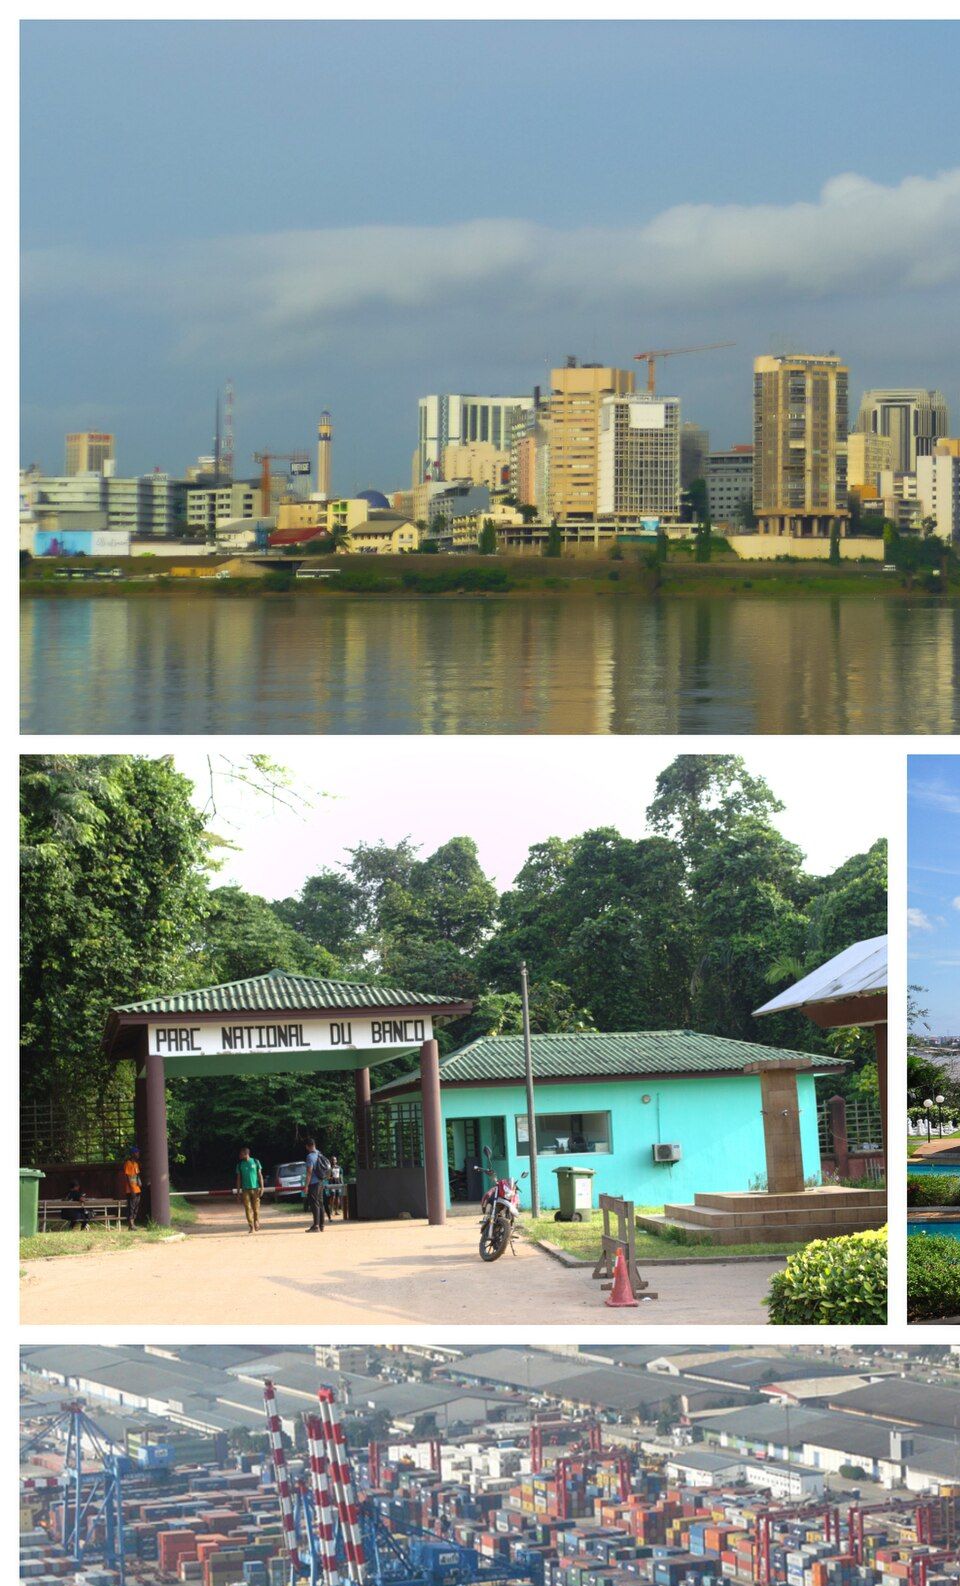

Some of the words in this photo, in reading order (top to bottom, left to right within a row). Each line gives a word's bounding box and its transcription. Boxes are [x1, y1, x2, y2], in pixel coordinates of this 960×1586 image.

[156, 1027, 202, 1052] PARC
[221, 1023, 310, 1049] NATIONAL
[330, 1022, 351, 1046] DU
[371, 1019, 425, 1043] BANCO
